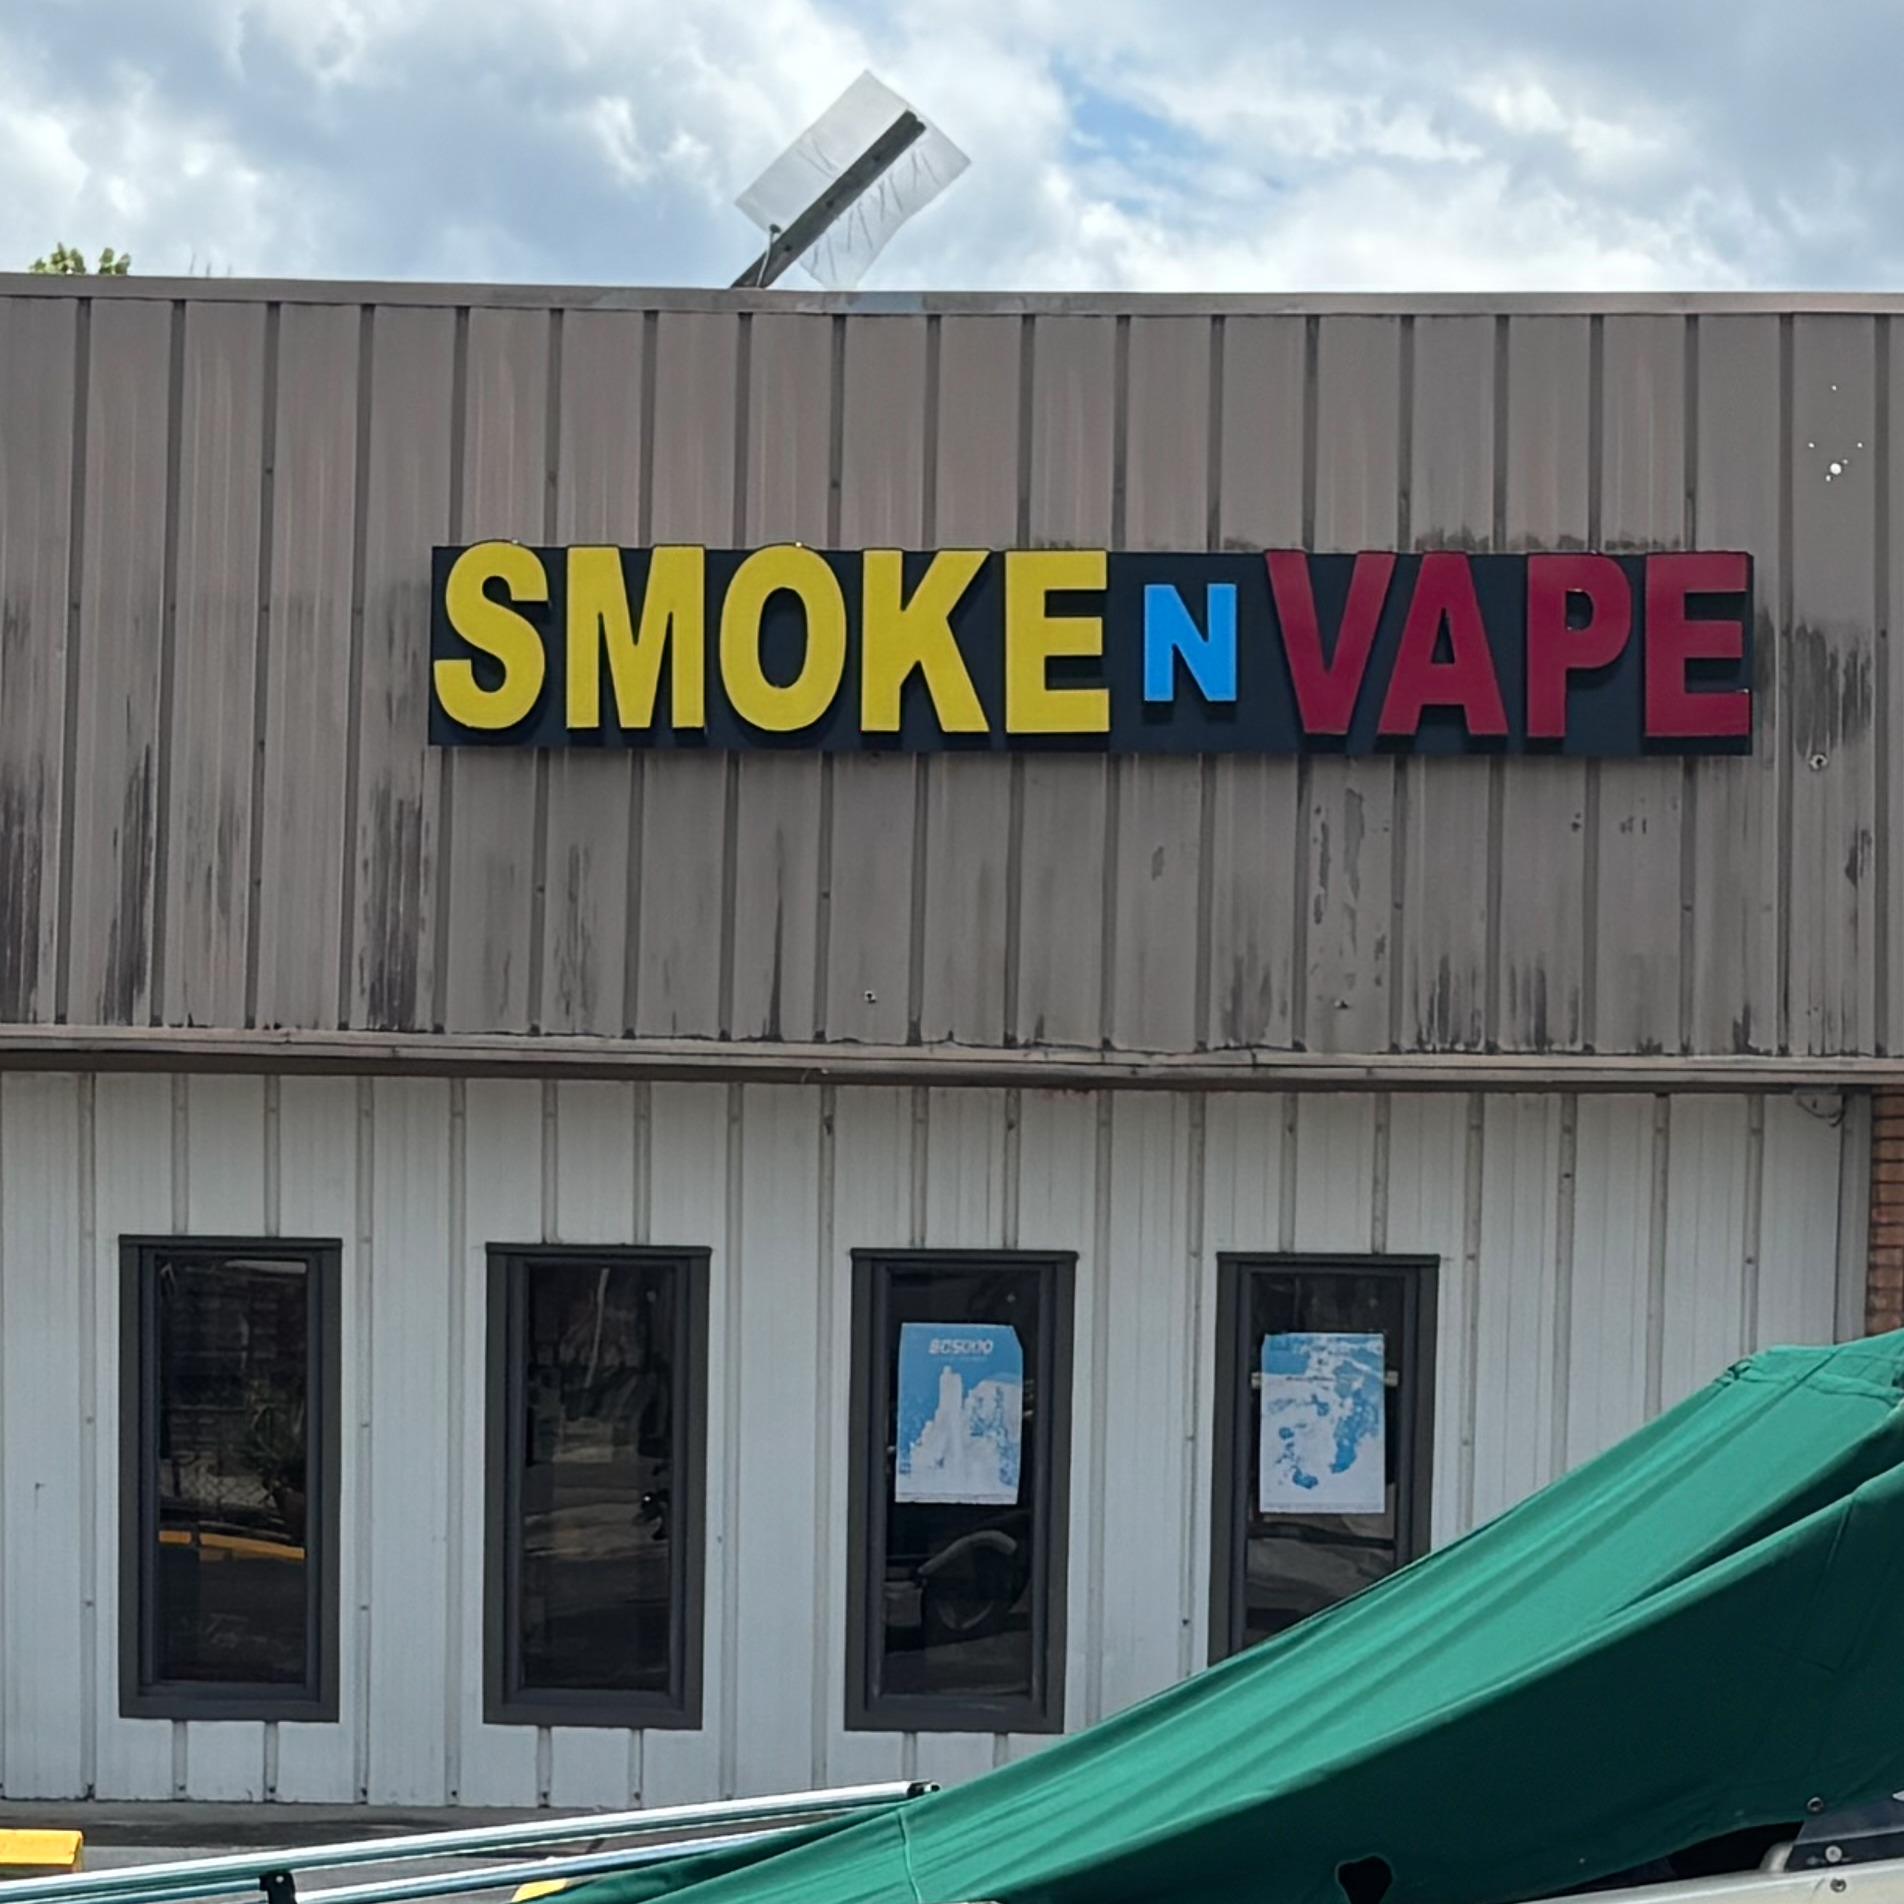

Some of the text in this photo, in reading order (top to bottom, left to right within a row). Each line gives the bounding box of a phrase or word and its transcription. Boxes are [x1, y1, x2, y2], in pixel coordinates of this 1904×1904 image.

[434, 541, 1752, 738] SMOKE N VAPE
